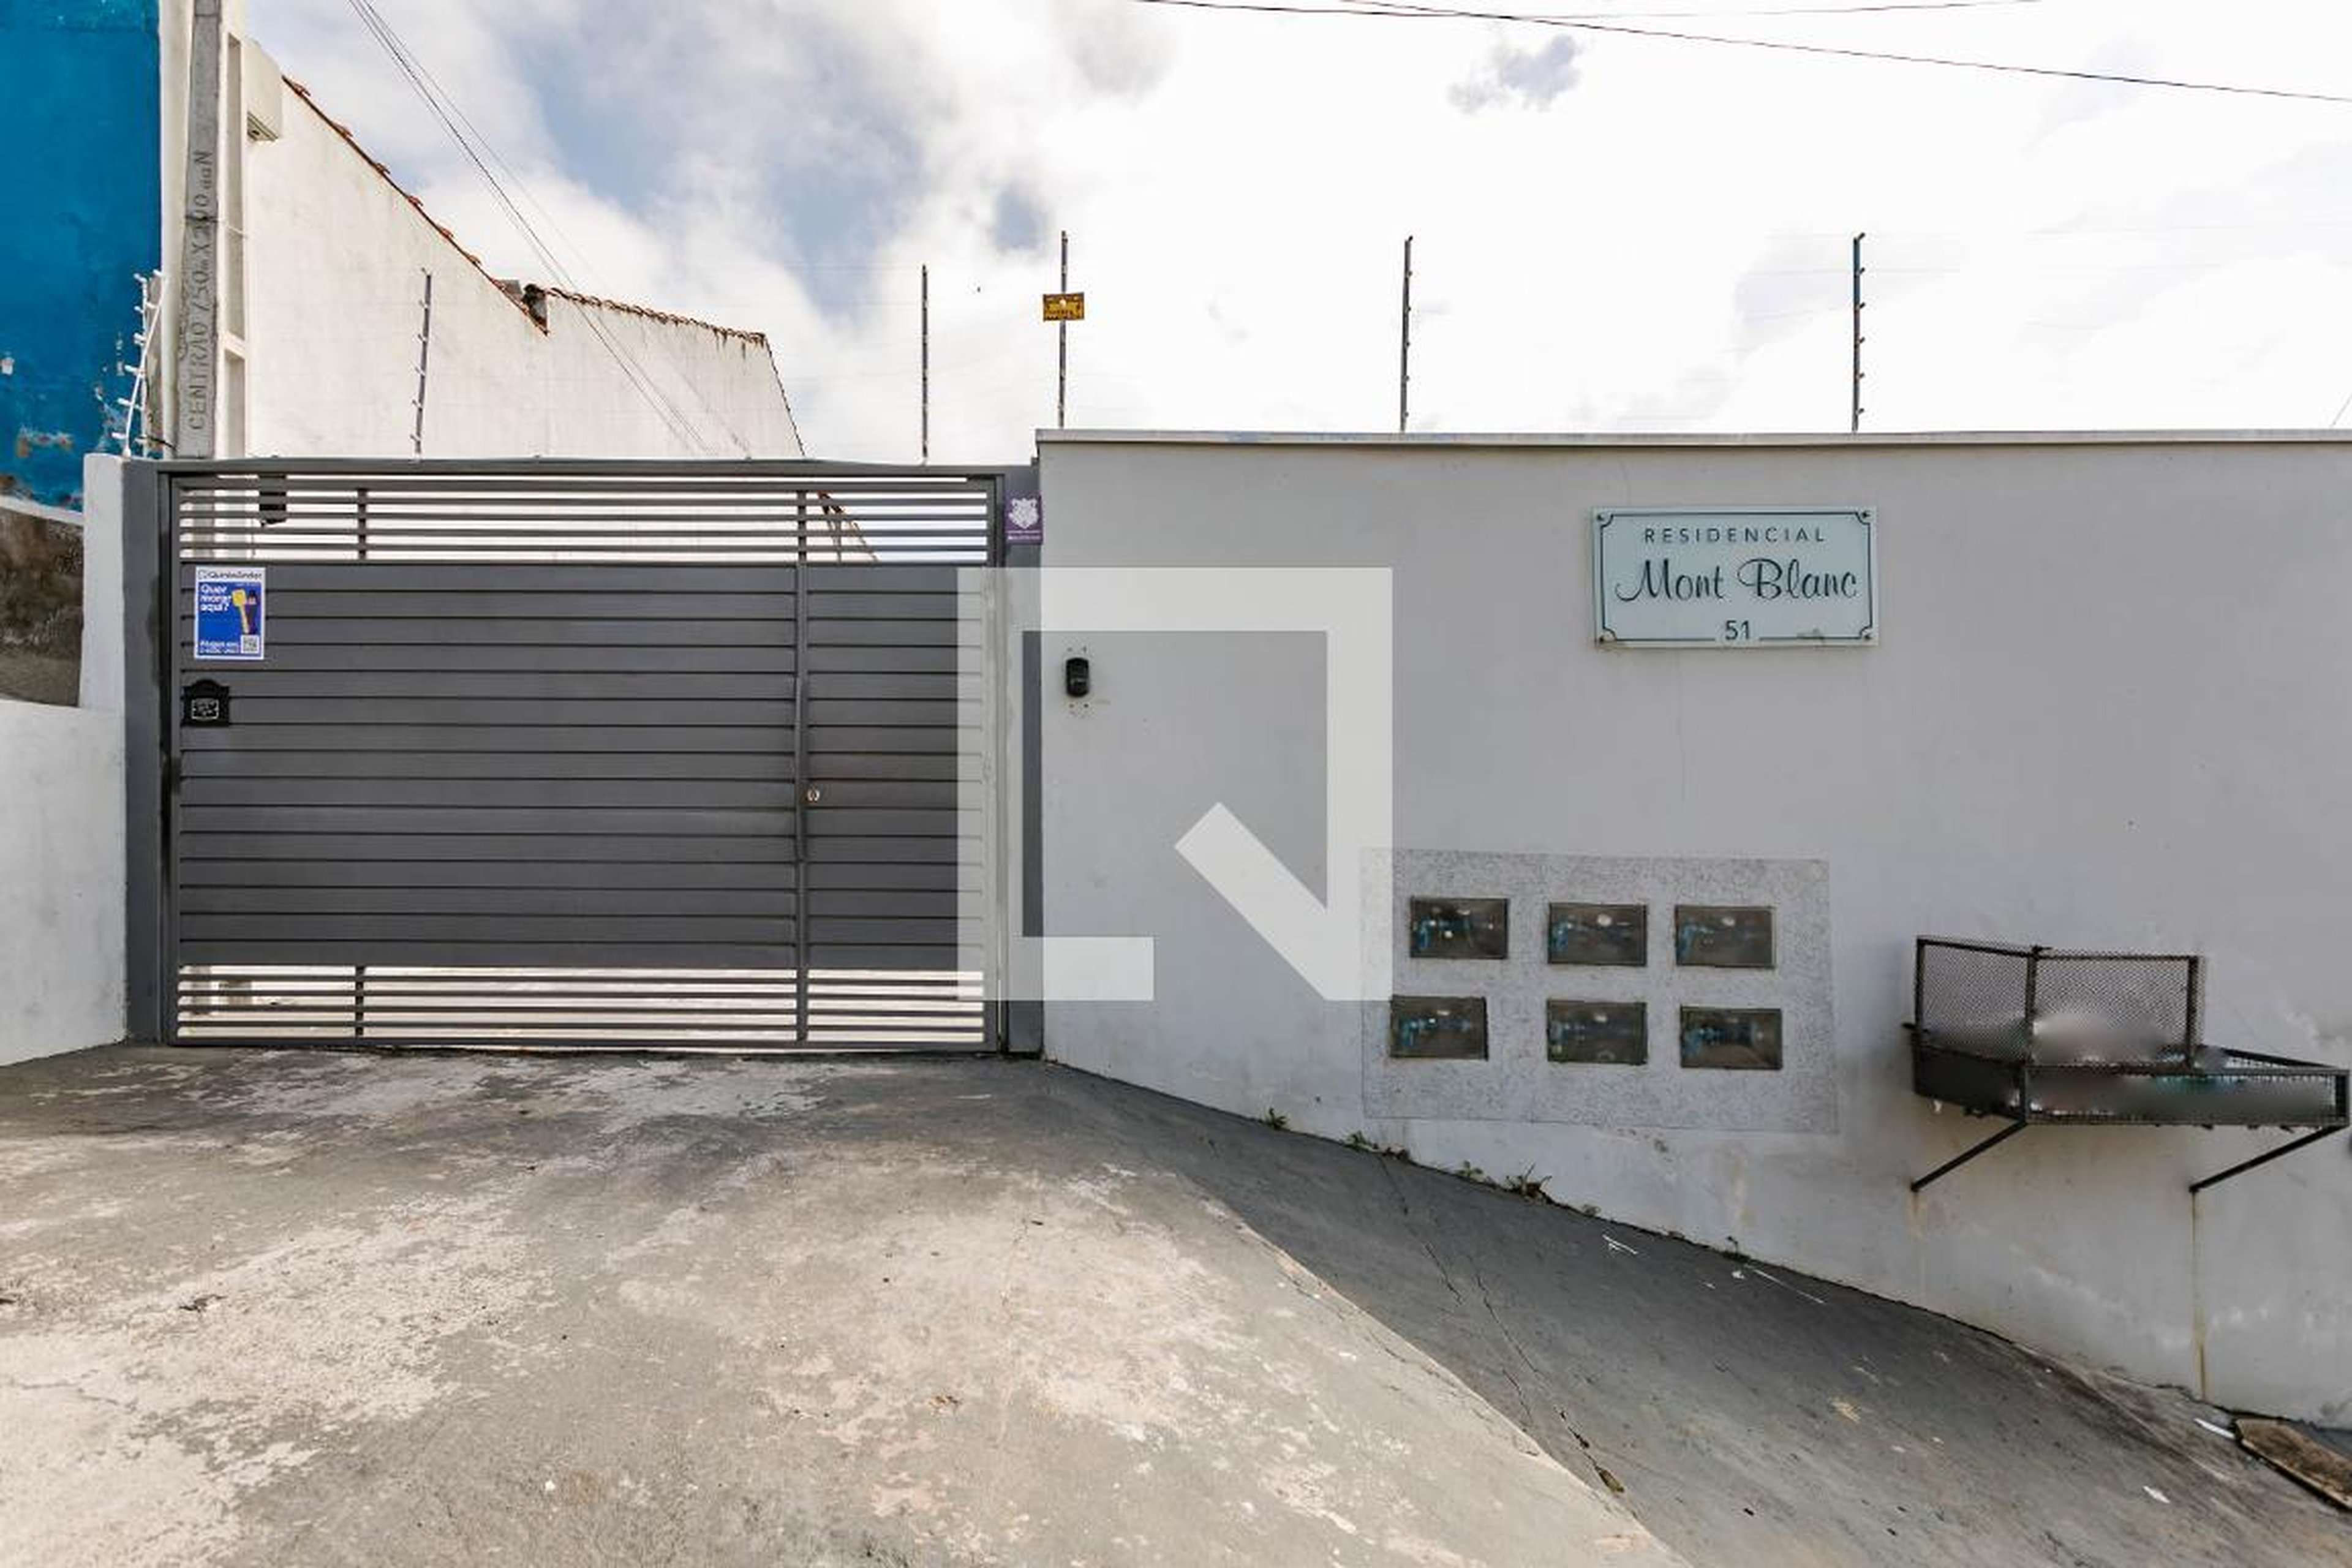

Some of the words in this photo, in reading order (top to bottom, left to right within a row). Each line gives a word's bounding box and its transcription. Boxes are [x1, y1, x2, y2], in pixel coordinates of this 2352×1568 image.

[1644, 527, 1825, 543] RESIDENCIAL
[1615, 557, 1725, 601] Mont
[1737, 558, 1857, 600] Blanc
[1725, 619, 1750, 641] 51
